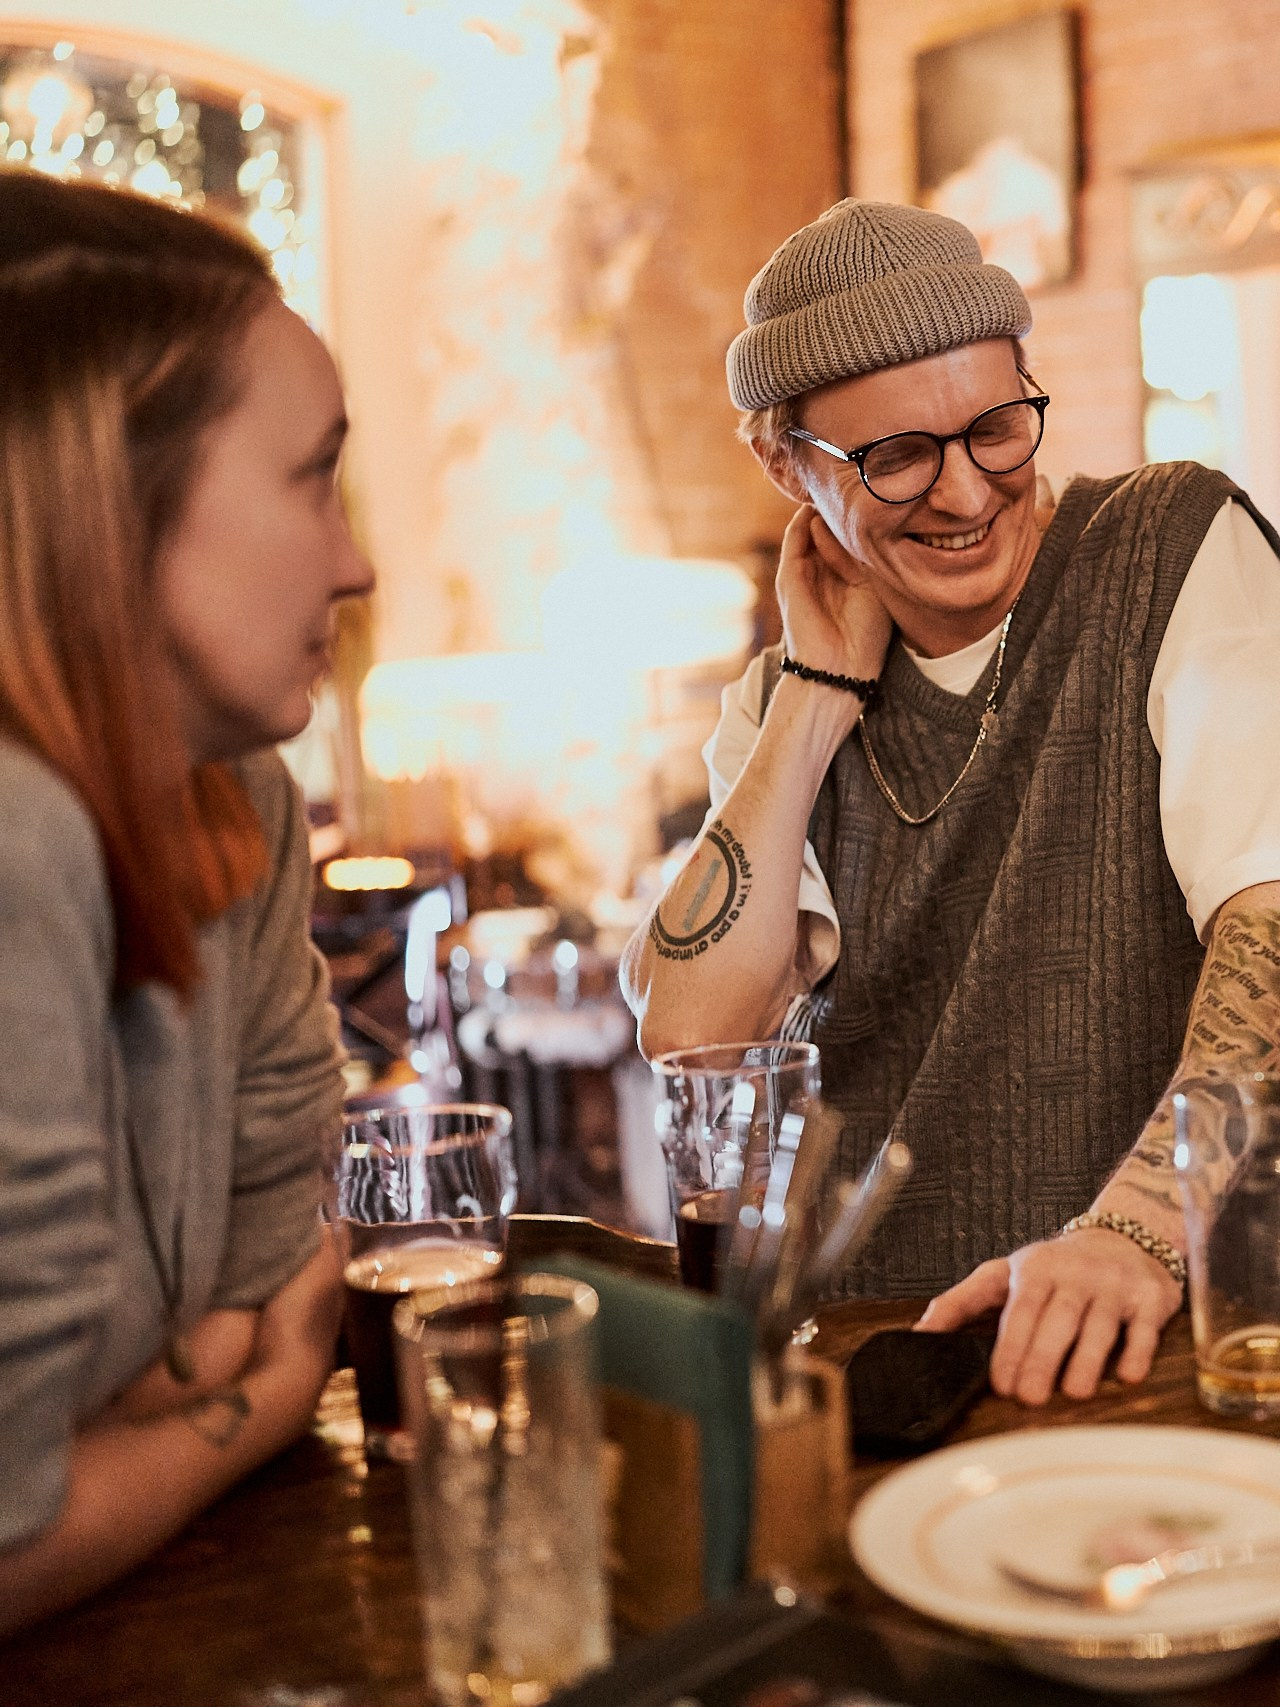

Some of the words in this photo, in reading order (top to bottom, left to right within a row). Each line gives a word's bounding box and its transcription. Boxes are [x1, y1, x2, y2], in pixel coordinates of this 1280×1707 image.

[721, 828, 734, 845] my
[732, 843, 752, 879] doubt
[729, 910, 740, 922] a
[711, 919, 732, 943] pro
[1229, 928, 1260, 949] give
[694, 940, 709, 956] at
[1219, 1007, 1248, 1026] ever
